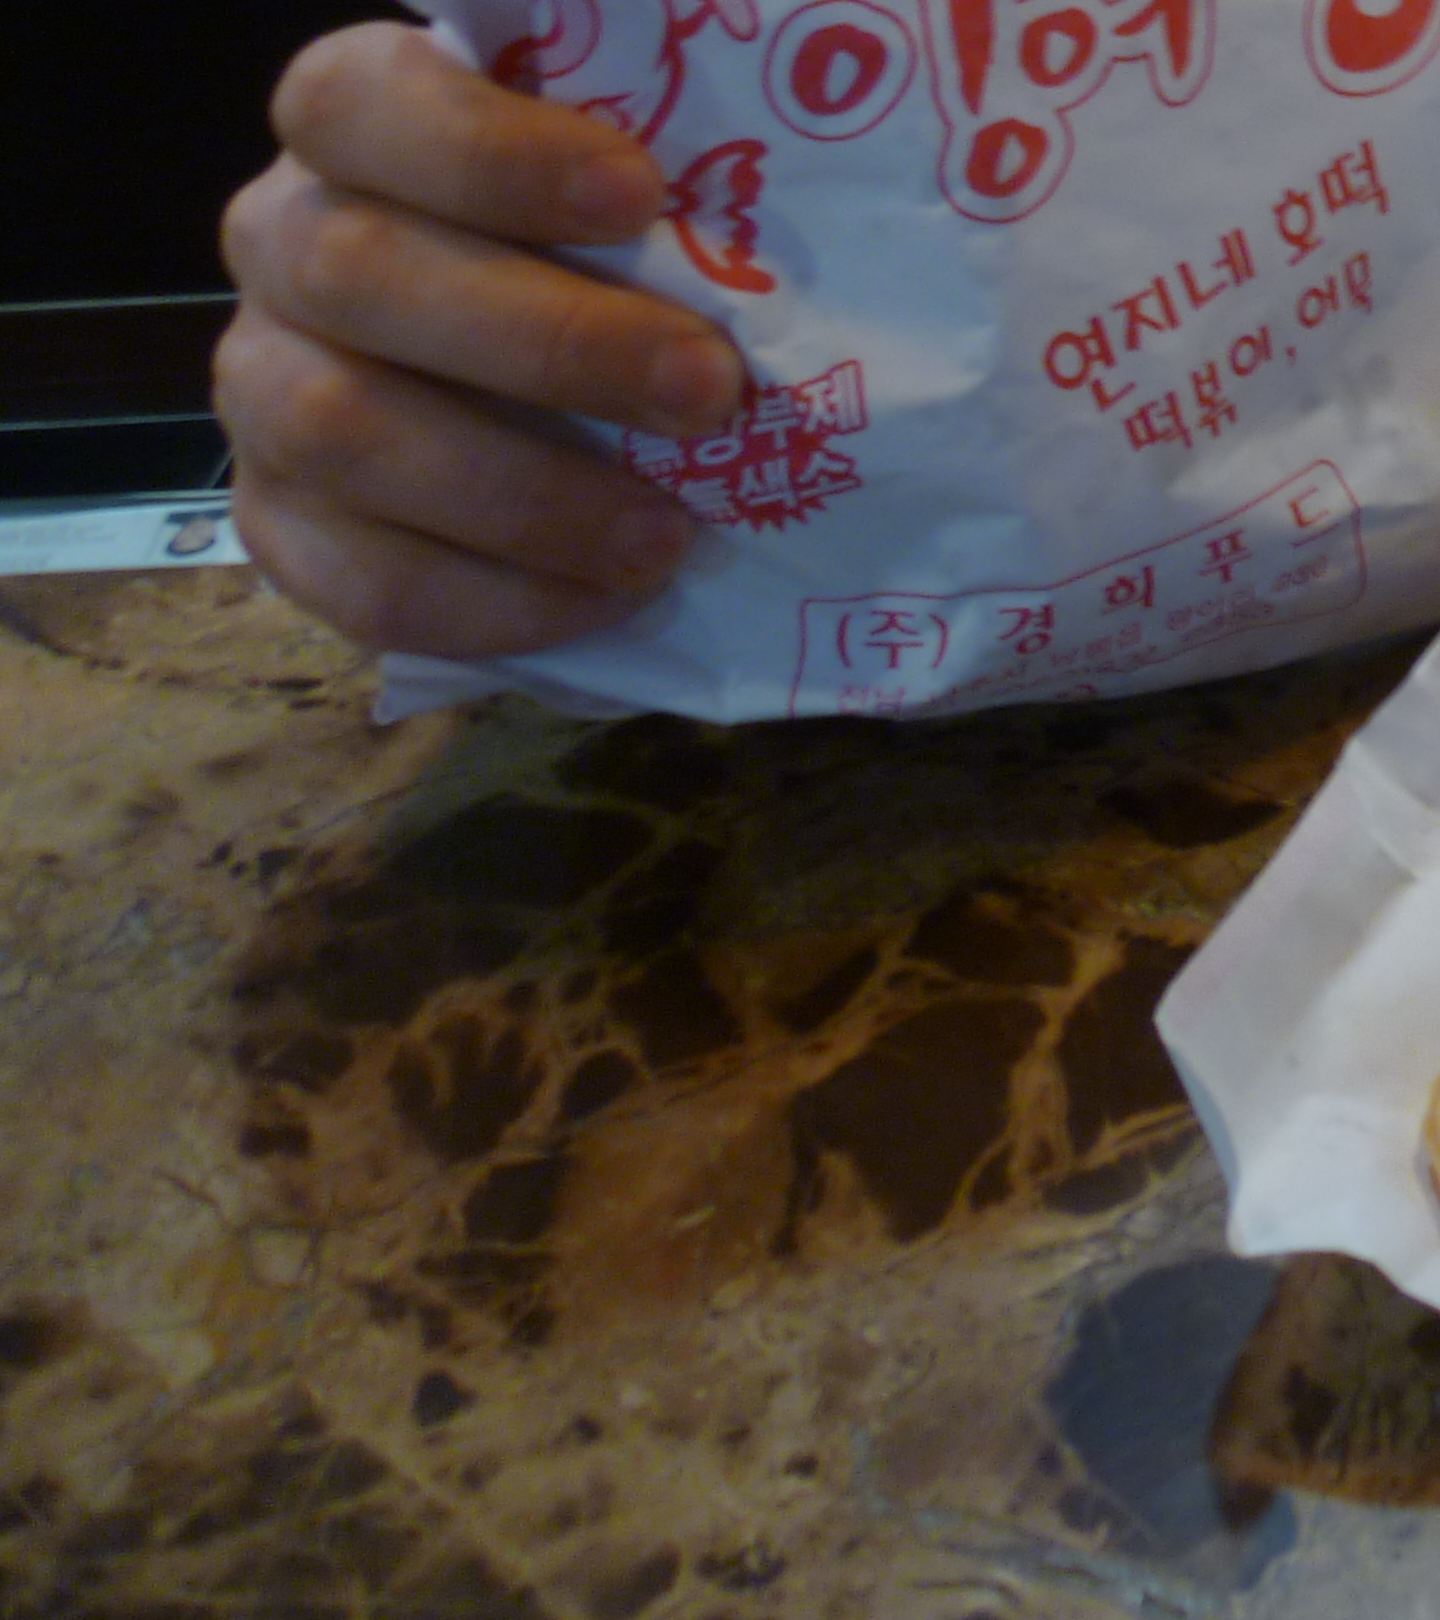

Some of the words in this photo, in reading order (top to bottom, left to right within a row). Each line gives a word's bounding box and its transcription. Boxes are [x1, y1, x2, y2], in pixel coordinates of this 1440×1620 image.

[1042, 227, 1256, 413] 연지네
[1271, 138, 1390, 267] 호떡
[836, 608, 948, 670] (주)
